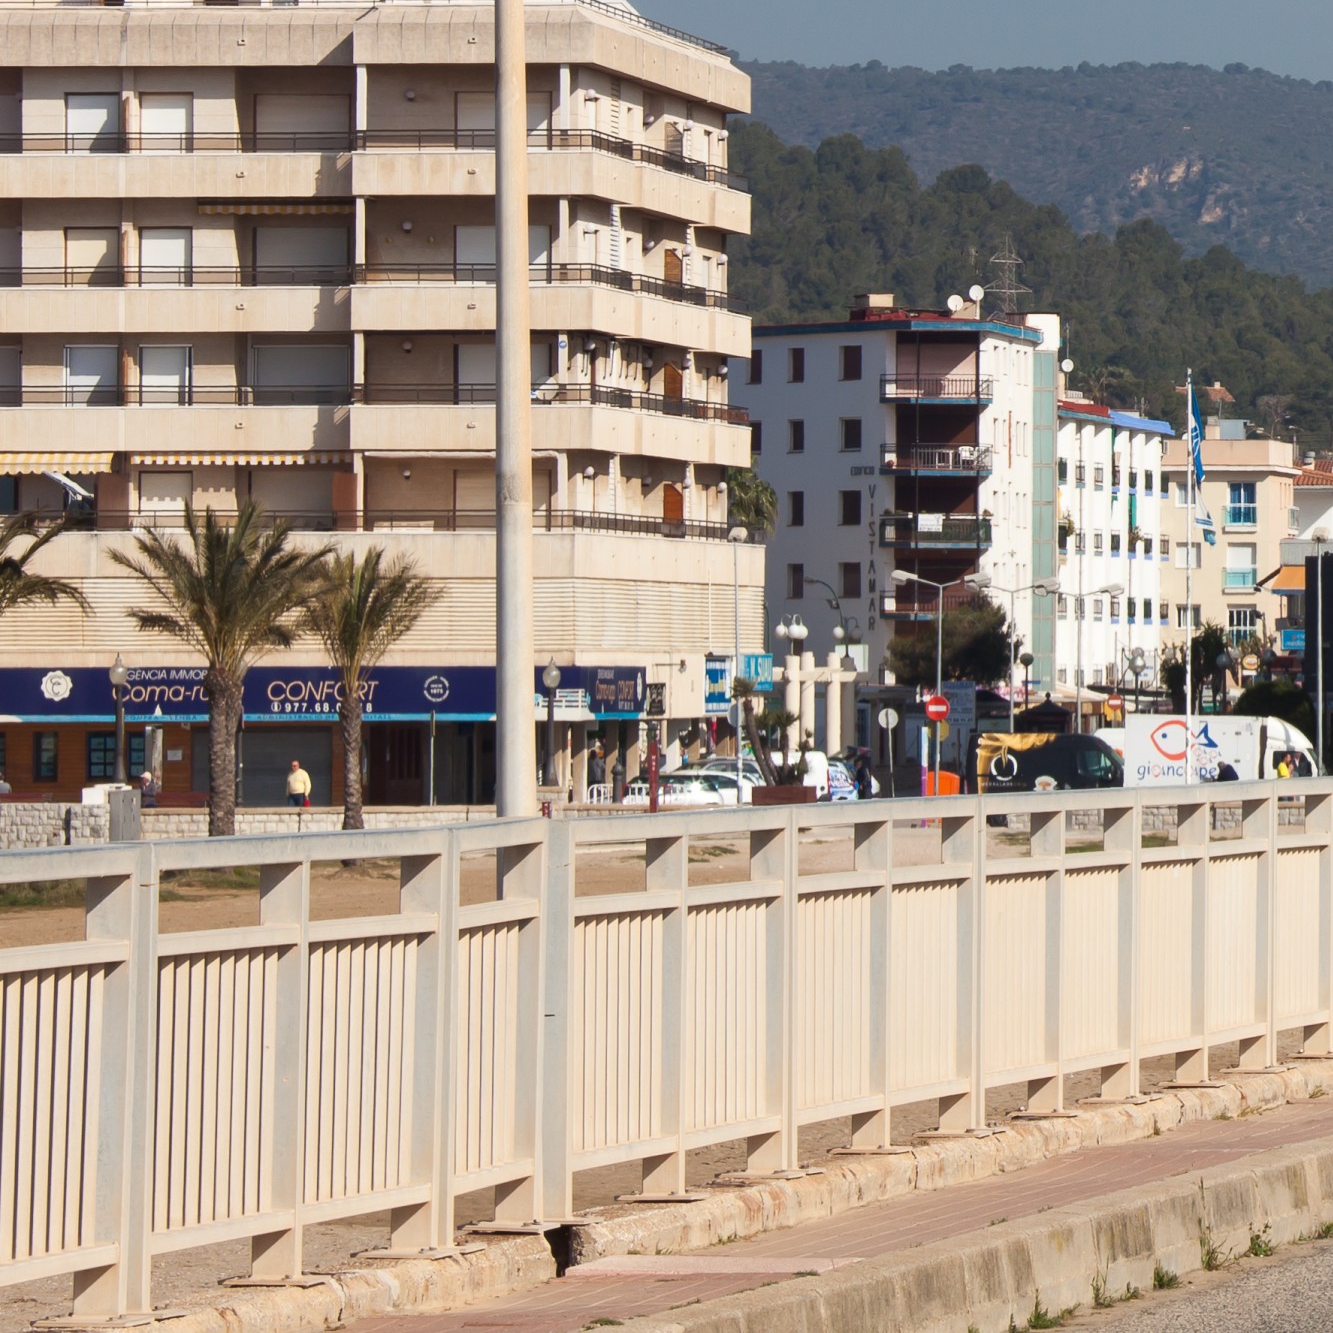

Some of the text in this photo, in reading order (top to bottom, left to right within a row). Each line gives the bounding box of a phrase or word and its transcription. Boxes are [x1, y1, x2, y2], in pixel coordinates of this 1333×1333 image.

[868, 484, 876, 631] VISTAMAR
[112, 682, 245, 702] Coma-ru
[284, 702, 373, 712] 977.68.0.8
